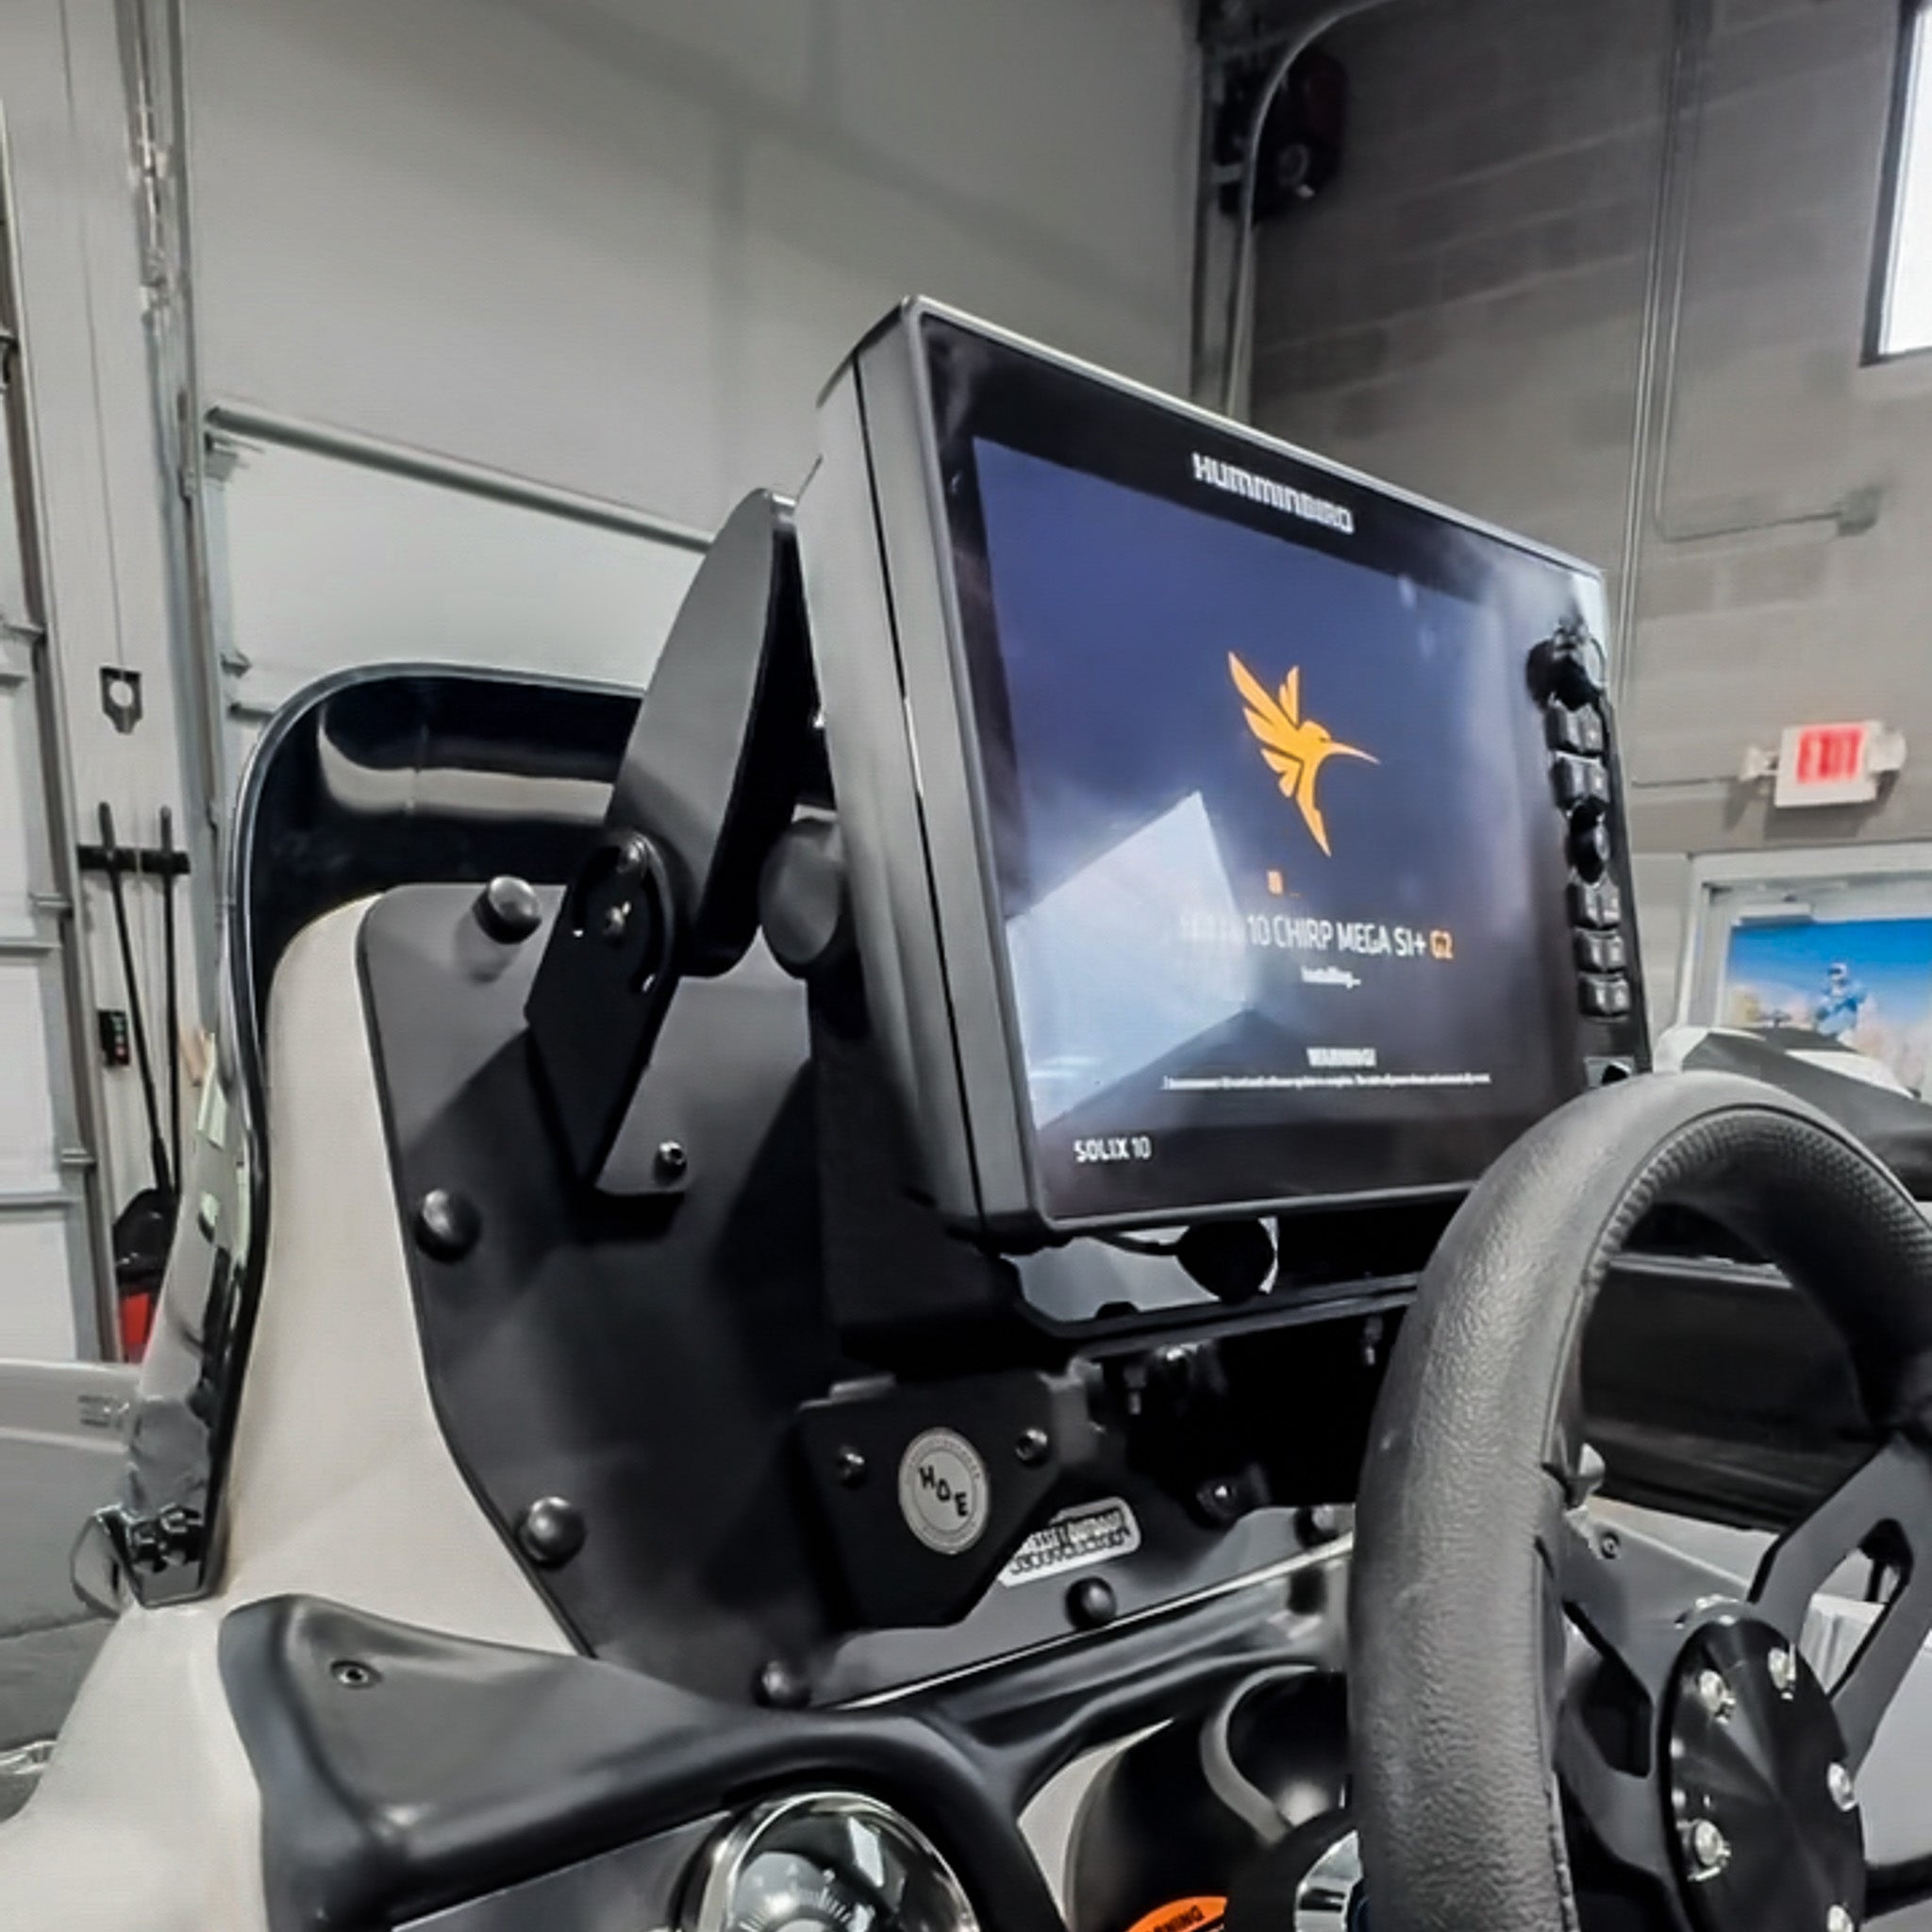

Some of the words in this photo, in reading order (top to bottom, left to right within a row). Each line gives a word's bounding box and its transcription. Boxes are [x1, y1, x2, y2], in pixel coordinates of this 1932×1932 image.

[1191, 452, 1356, 536] HUMMINBIRD
[1246, 913, 1272, 946] 10
[1272, 913, 1334, 951] CHIRP
[1336, 921, 1392, 956] MEGA
[1429, 929, 1455, 959] G2
[1074, 1138, 1130, 1163] SOLIX
[1131, 1135, 1153, 1161] 10
